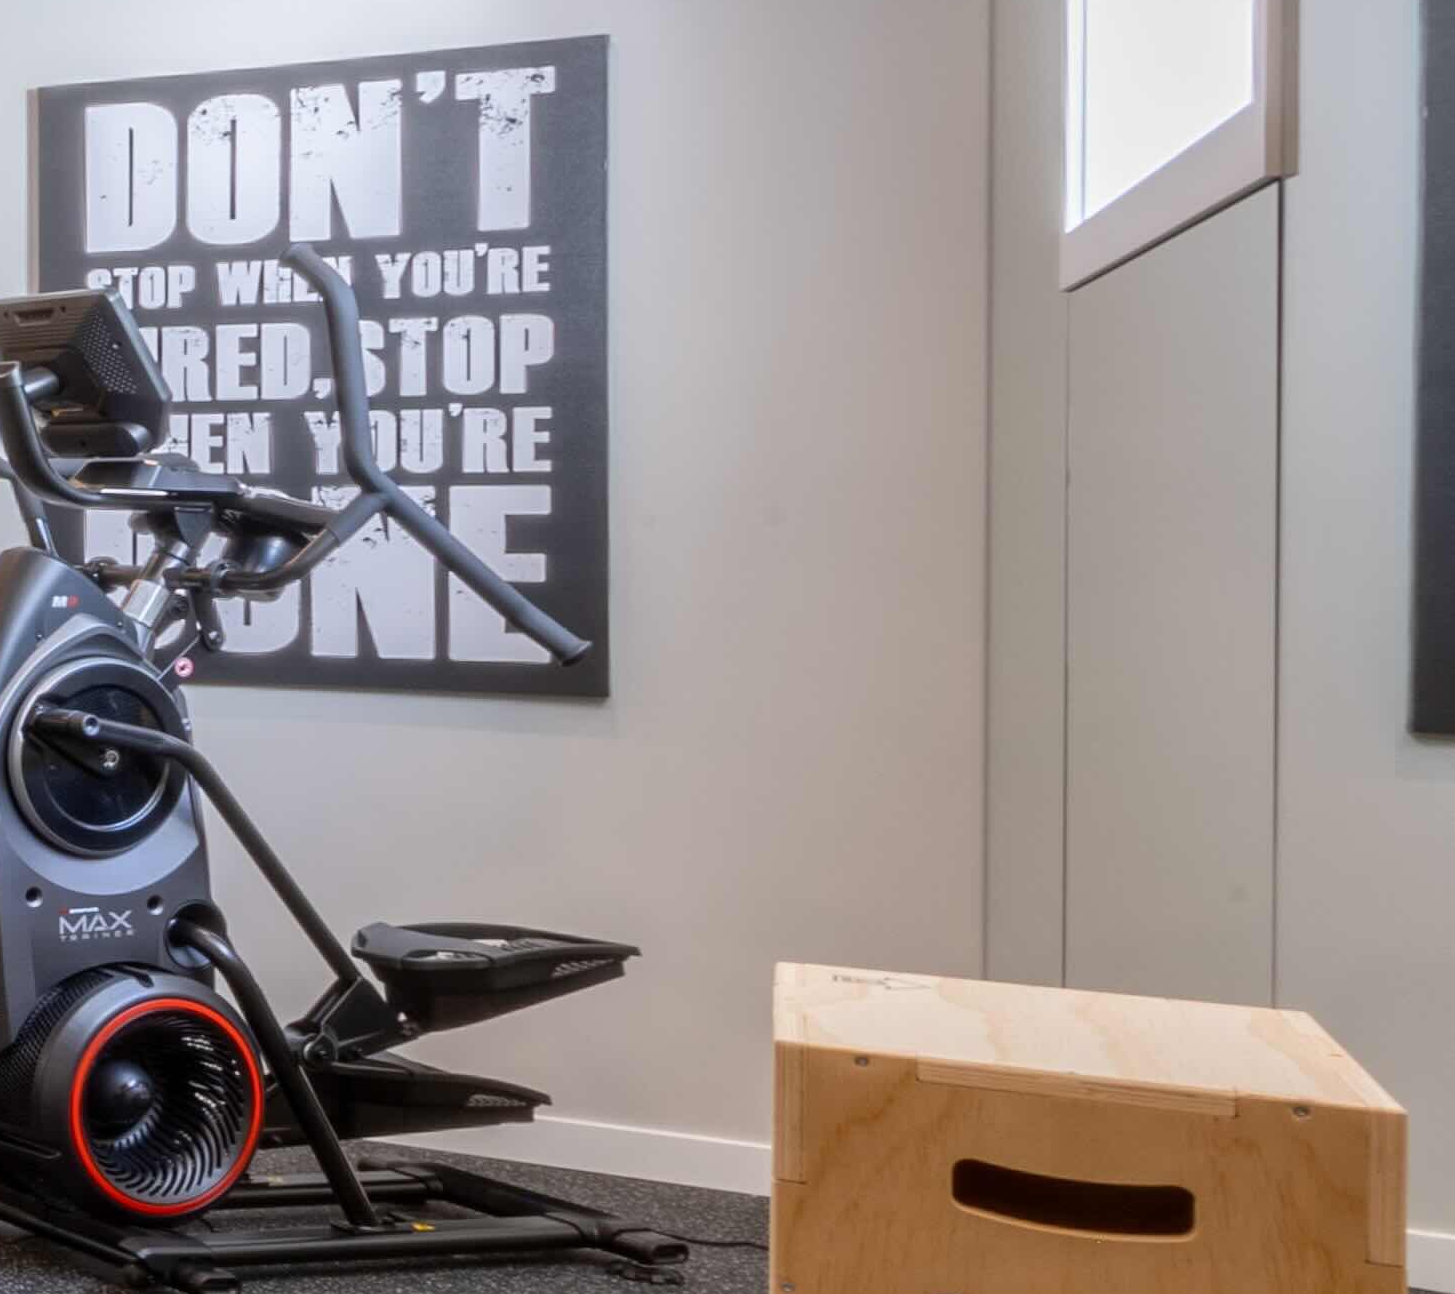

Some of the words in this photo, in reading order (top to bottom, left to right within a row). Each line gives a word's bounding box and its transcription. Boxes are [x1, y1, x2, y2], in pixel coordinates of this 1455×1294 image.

[85, 65, 556, 253] DON'T
[375, 243, 551, 299] YOU'RE
[138, 322, 332, 402] RED,
[152, 412, 272, 475] EN
[304, 403, 553, 475] YOU'RE
[59, 910, 132, 934] MAX
